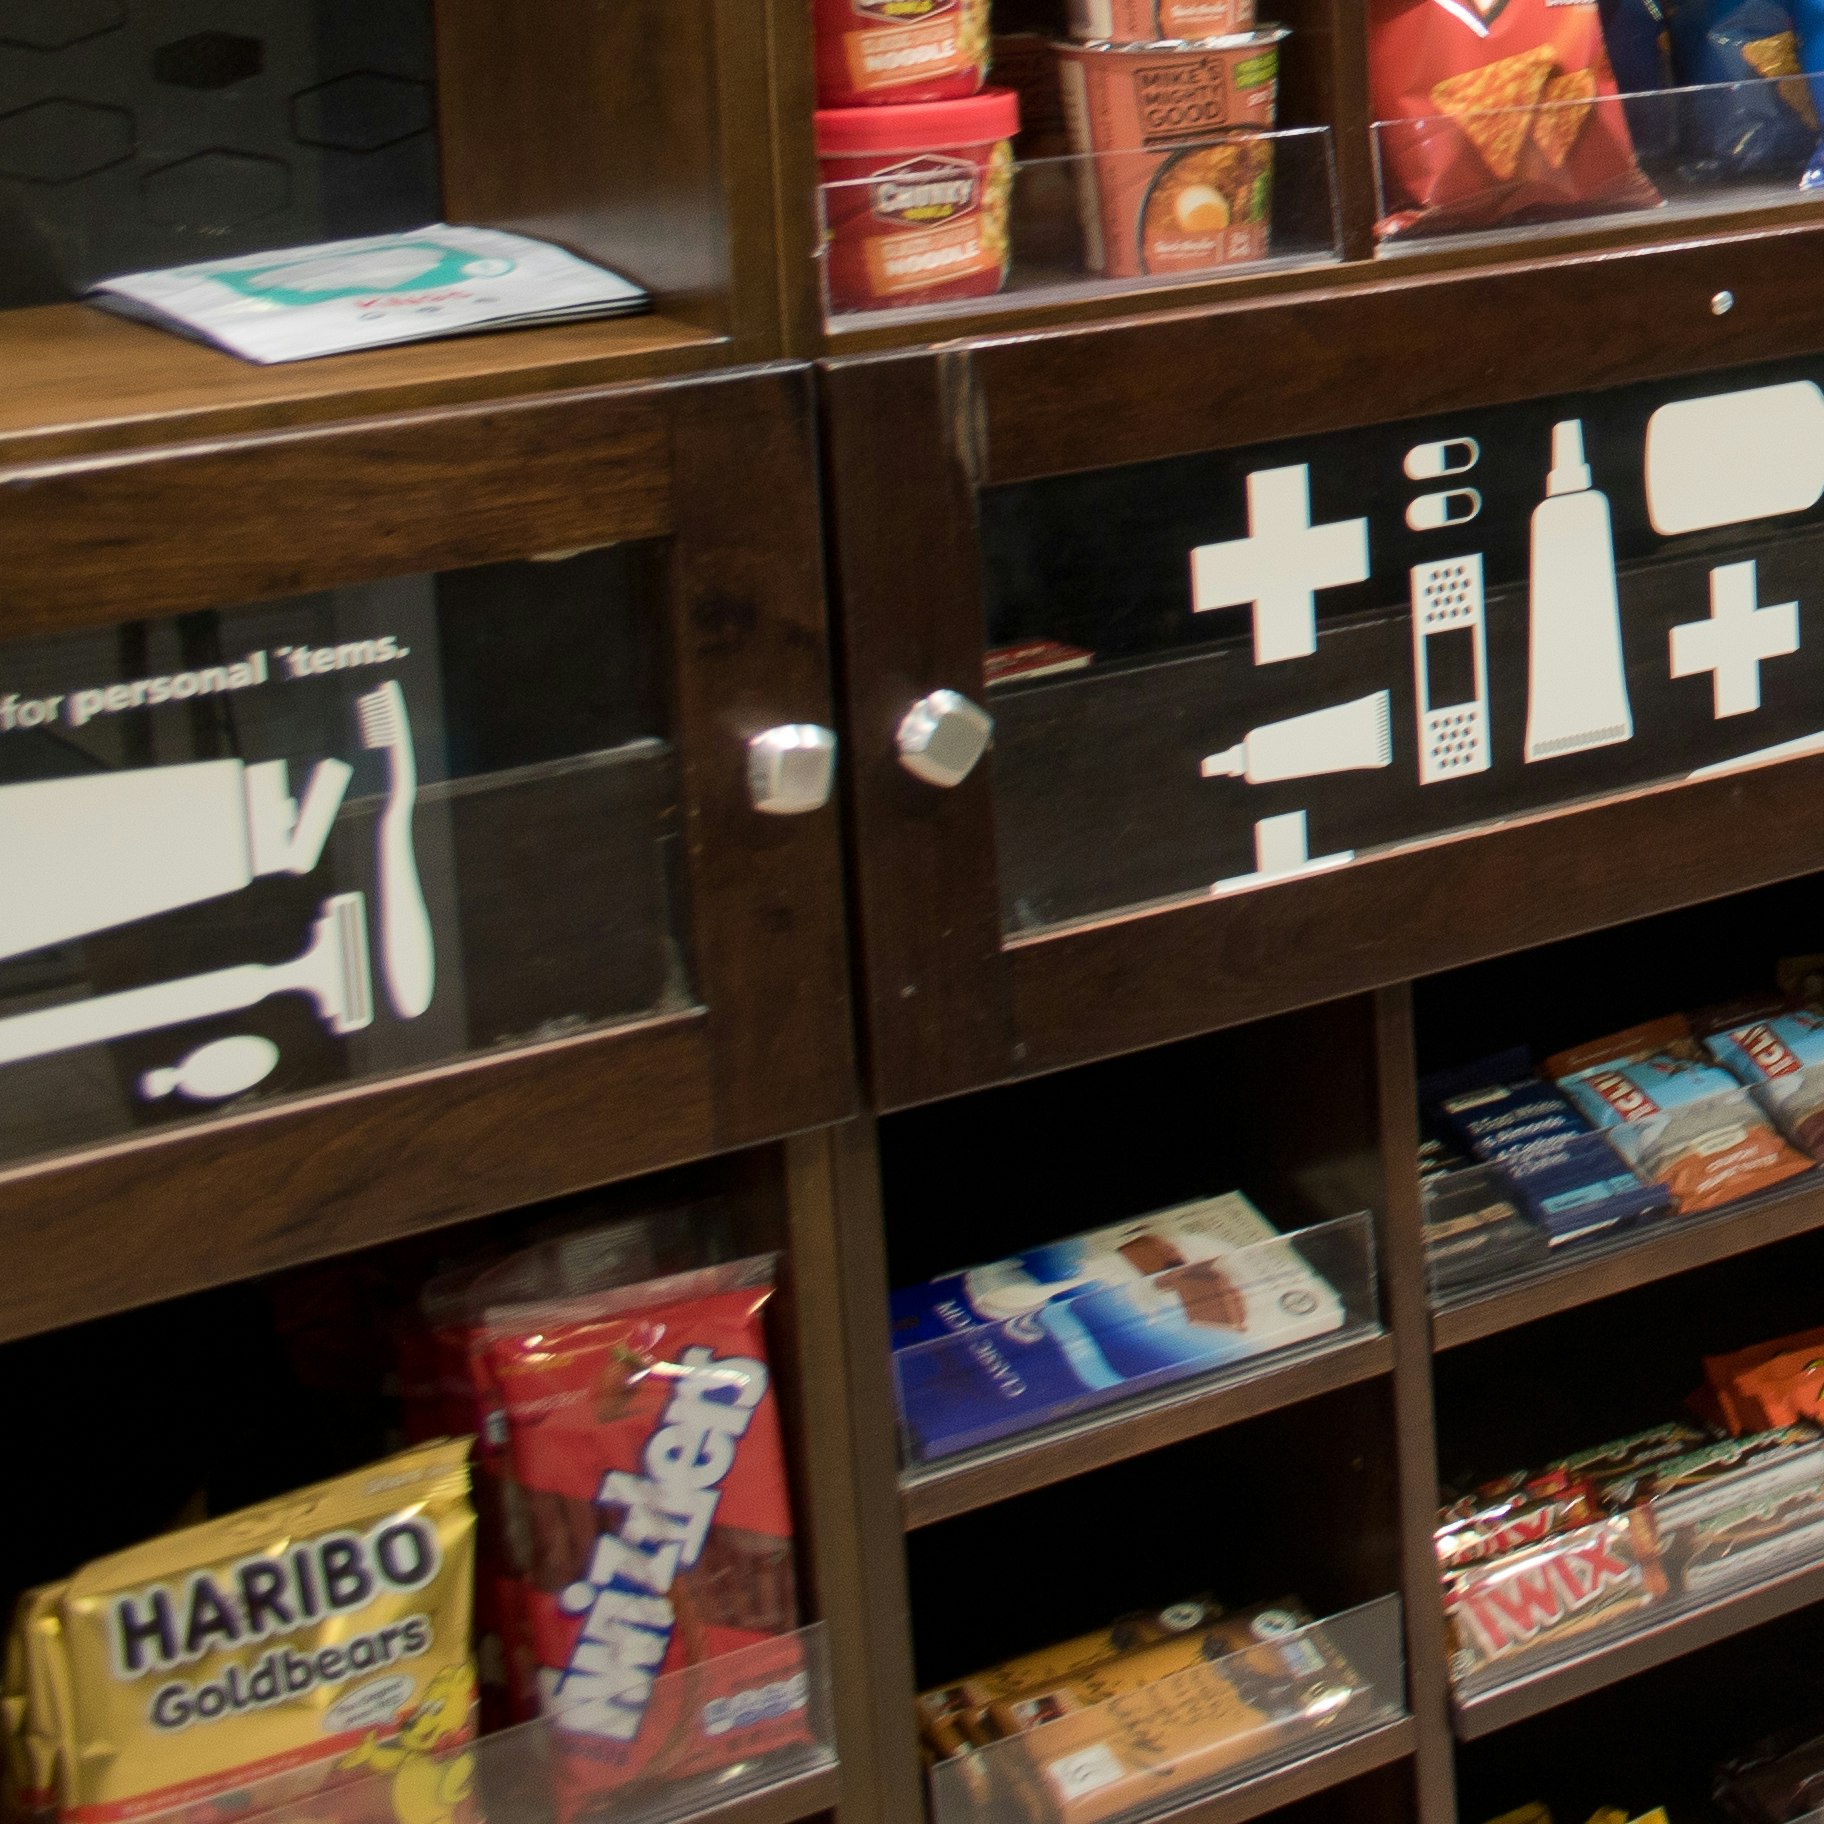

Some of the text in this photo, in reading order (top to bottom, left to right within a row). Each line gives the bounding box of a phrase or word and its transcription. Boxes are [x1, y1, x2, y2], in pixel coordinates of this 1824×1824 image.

[0, 690, 62, 733] for
[66, 650, 269, 727] personal
[113, 1518, 438, 1673] HARIBO
[1462, 1531, 1634, 1659] TWIX
[150, 1614, 433, 1729] Goldbears
